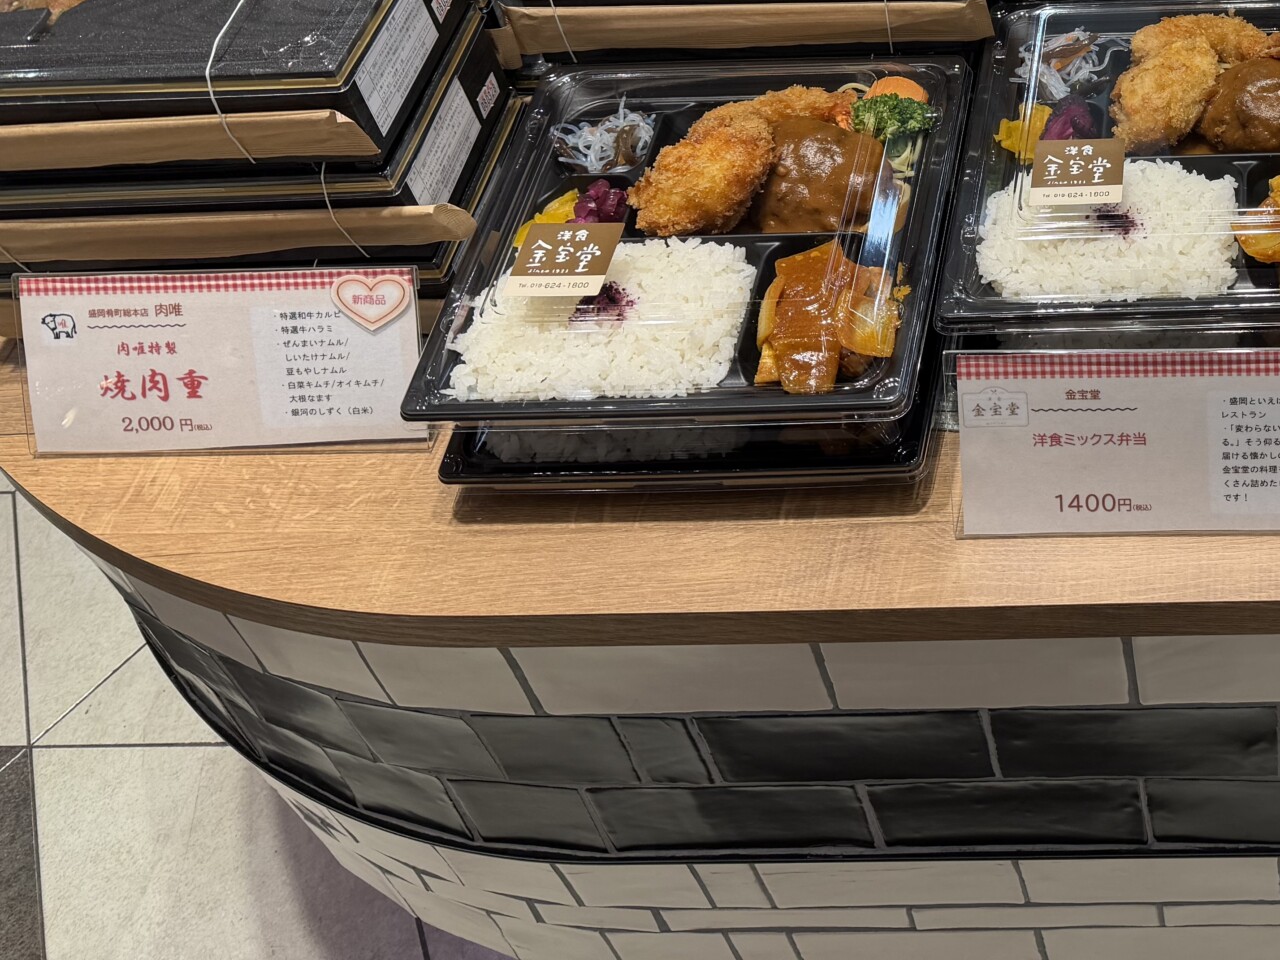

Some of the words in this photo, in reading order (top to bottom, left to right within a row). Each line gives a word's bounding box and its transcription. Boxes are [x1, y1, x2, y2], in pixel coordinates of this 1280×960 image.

[1064, 144, 1094, 155] 洋食
[1043, 154, 1112, 183] 金宝堂
[557, 229, 589, 241] 洋食
[525, 240, 601, 272] 金宝堂
[352, 294, 387, 306] 新商品
[88, 308, 149, 318] 盛岡肴町総本店
[154, 302, 184, 317] 肉唯
[117, 340, 178, 356] 肉唯特製
[285, 367, 347, 376] 豆もやしナムル
[99, 368, 209, 402] 焼肉重
[289, 394, 333, 403] 大根なます
[1065, 389, 1102, 400] 金宝堂
[972, 402, 1020, 417] 金宝堂
[1221, 410, 1267, 419] レストラン
[122, 416, 175, 433] 2,000
[1032, 432, 1147, 448] 洋食ミックス弁当
[1223, 492, 1248, 502] です！
